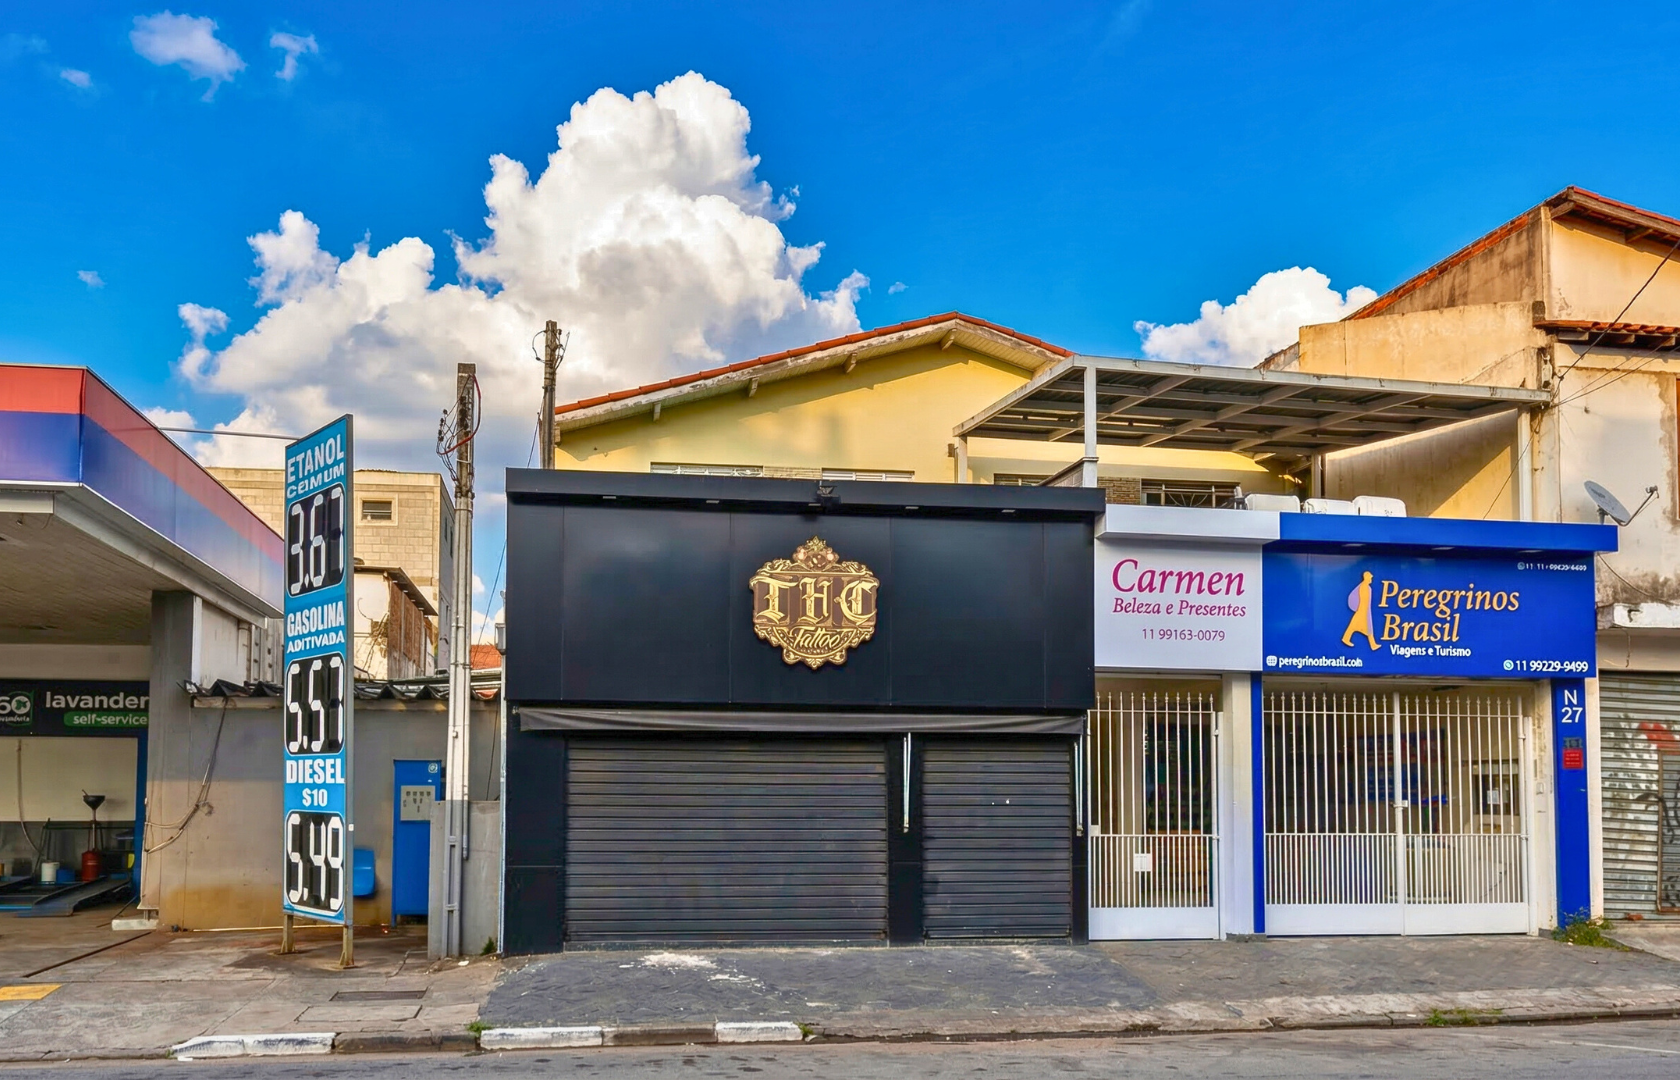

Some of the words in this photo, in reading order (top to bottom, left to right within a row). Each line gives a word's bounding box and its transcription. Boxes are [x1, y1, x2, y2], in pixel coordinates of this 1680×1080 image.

[287, 434, 345, 484] ETANOL
[1112, 558, 1245, 596] Carmen
[1112, 597, 1162, 615] Beleza
[1166, 603, 1174, 615] e
[1177, 600, 1247, 617] Presentes
[1378, 579, 1520, 618] Peregrinos
[287, 600, 345, 637] GASOLINA
[1380, 613, 1461, 642] Brasil
[286, 630, 345, 653] ADITIVADA
[790, 626, 841, 649] Tattoo
[1142, 628, 1154, 640] 11
[1158, 629, 1226, 641] 99163-0079
[1390, 644, 1427, 658] Viagens
[1427, 647, 1434, 656] e
[1434, 645, 1472, 657] Turismo
[1516, 660, 1527, 671] 11
[1529, 660, 1589, 672] 99229-9499
[1564, 689, 1578, 706] N
[73, 713, 148, 725] self-service
[1561, 706, 1584, 723] 27
[286, 758, 345, 784] DIESEL
